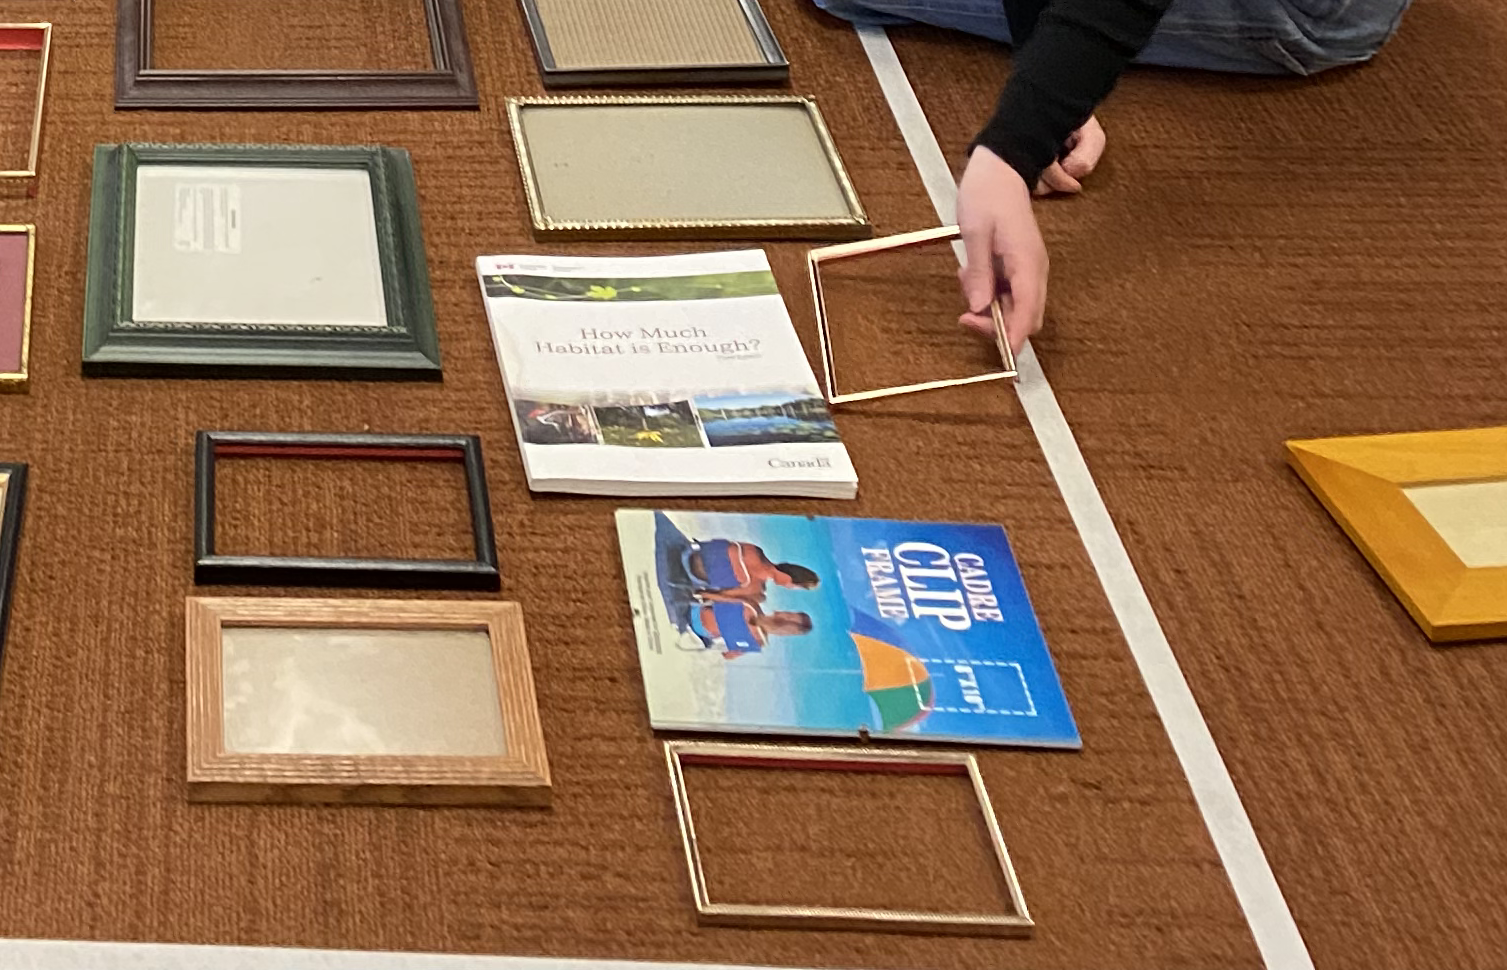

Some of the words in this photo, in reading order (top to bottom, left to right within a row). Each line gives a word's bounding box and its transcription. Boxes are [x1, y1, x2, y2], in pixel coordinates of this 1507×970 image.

[535, 341, 624, 355] Habitat
[631, 341, 651, 354] is
[658, 338, 761, 358] Enough?
[580, 328, 634, 340] How
[640, 326, 708, 340] Much
[860, 546, 910, 619] FRAME
[893, 541, 972, 631] CLIP
[953, 552, 1005, 622] CADRE
